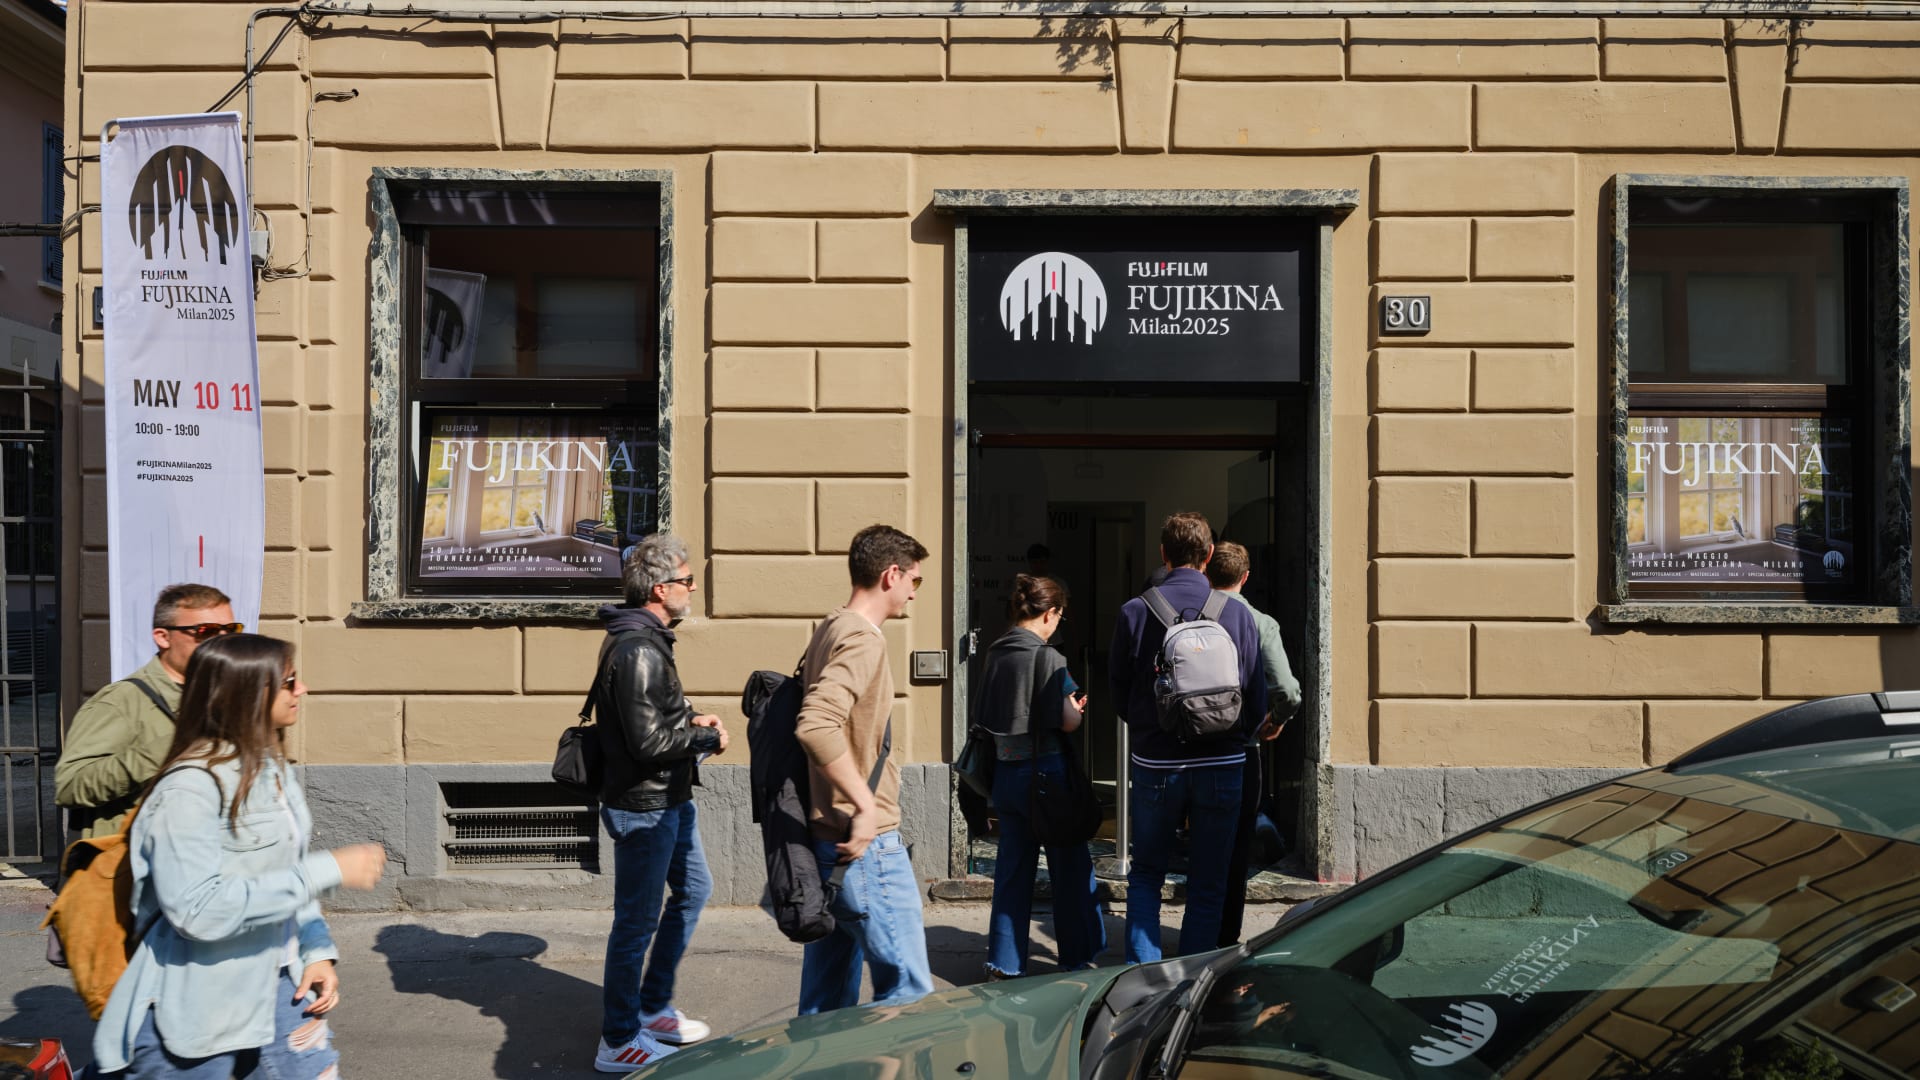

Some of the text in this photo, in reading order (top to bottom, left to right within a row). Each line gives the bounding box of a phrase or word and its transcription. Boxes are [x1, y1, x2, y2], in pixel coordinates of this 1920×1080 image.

[141, 269, 188, 281] FUJIFILM
[1128, 261, 1208, 278] FUJIFILM
[141, 285, 233, 309] FUJIKINA
[1127, 284, 1284, 321] FUJIKINA
[177, 307, 235, 321] Milan2025
[1387, 299, 1426, 328] 30
[1128, 316, 1231, 336] Milan2025
[133, 378, 253, 412] MAY 10 11
[135, 422, 164, 435] 10:00
[174, 424, 200, 437] 19:00
[1631, 425, 1669, 434] FUJIFILM
[136, 459, 213, 470] #FUJIKINAMilan2025
[437, 440, 636, 483] FUJIKINA
[1631, 442, 1830, 487] FUJIKINA
[136, 473, 194, 482] #FUJIKINA2025
[492, 555, 540, 563] TORTONA
[561, 555, 602, 563] MILANO
[1663, 552, 1673, 560] 11
[1687, 552, 1729, 560] MAGGIO
[1631, 560, 1686, 568] TORNERIA
[1694, 560, 1742, 568] TORTONA
[1763, 560, 1804, 569] MILANO
